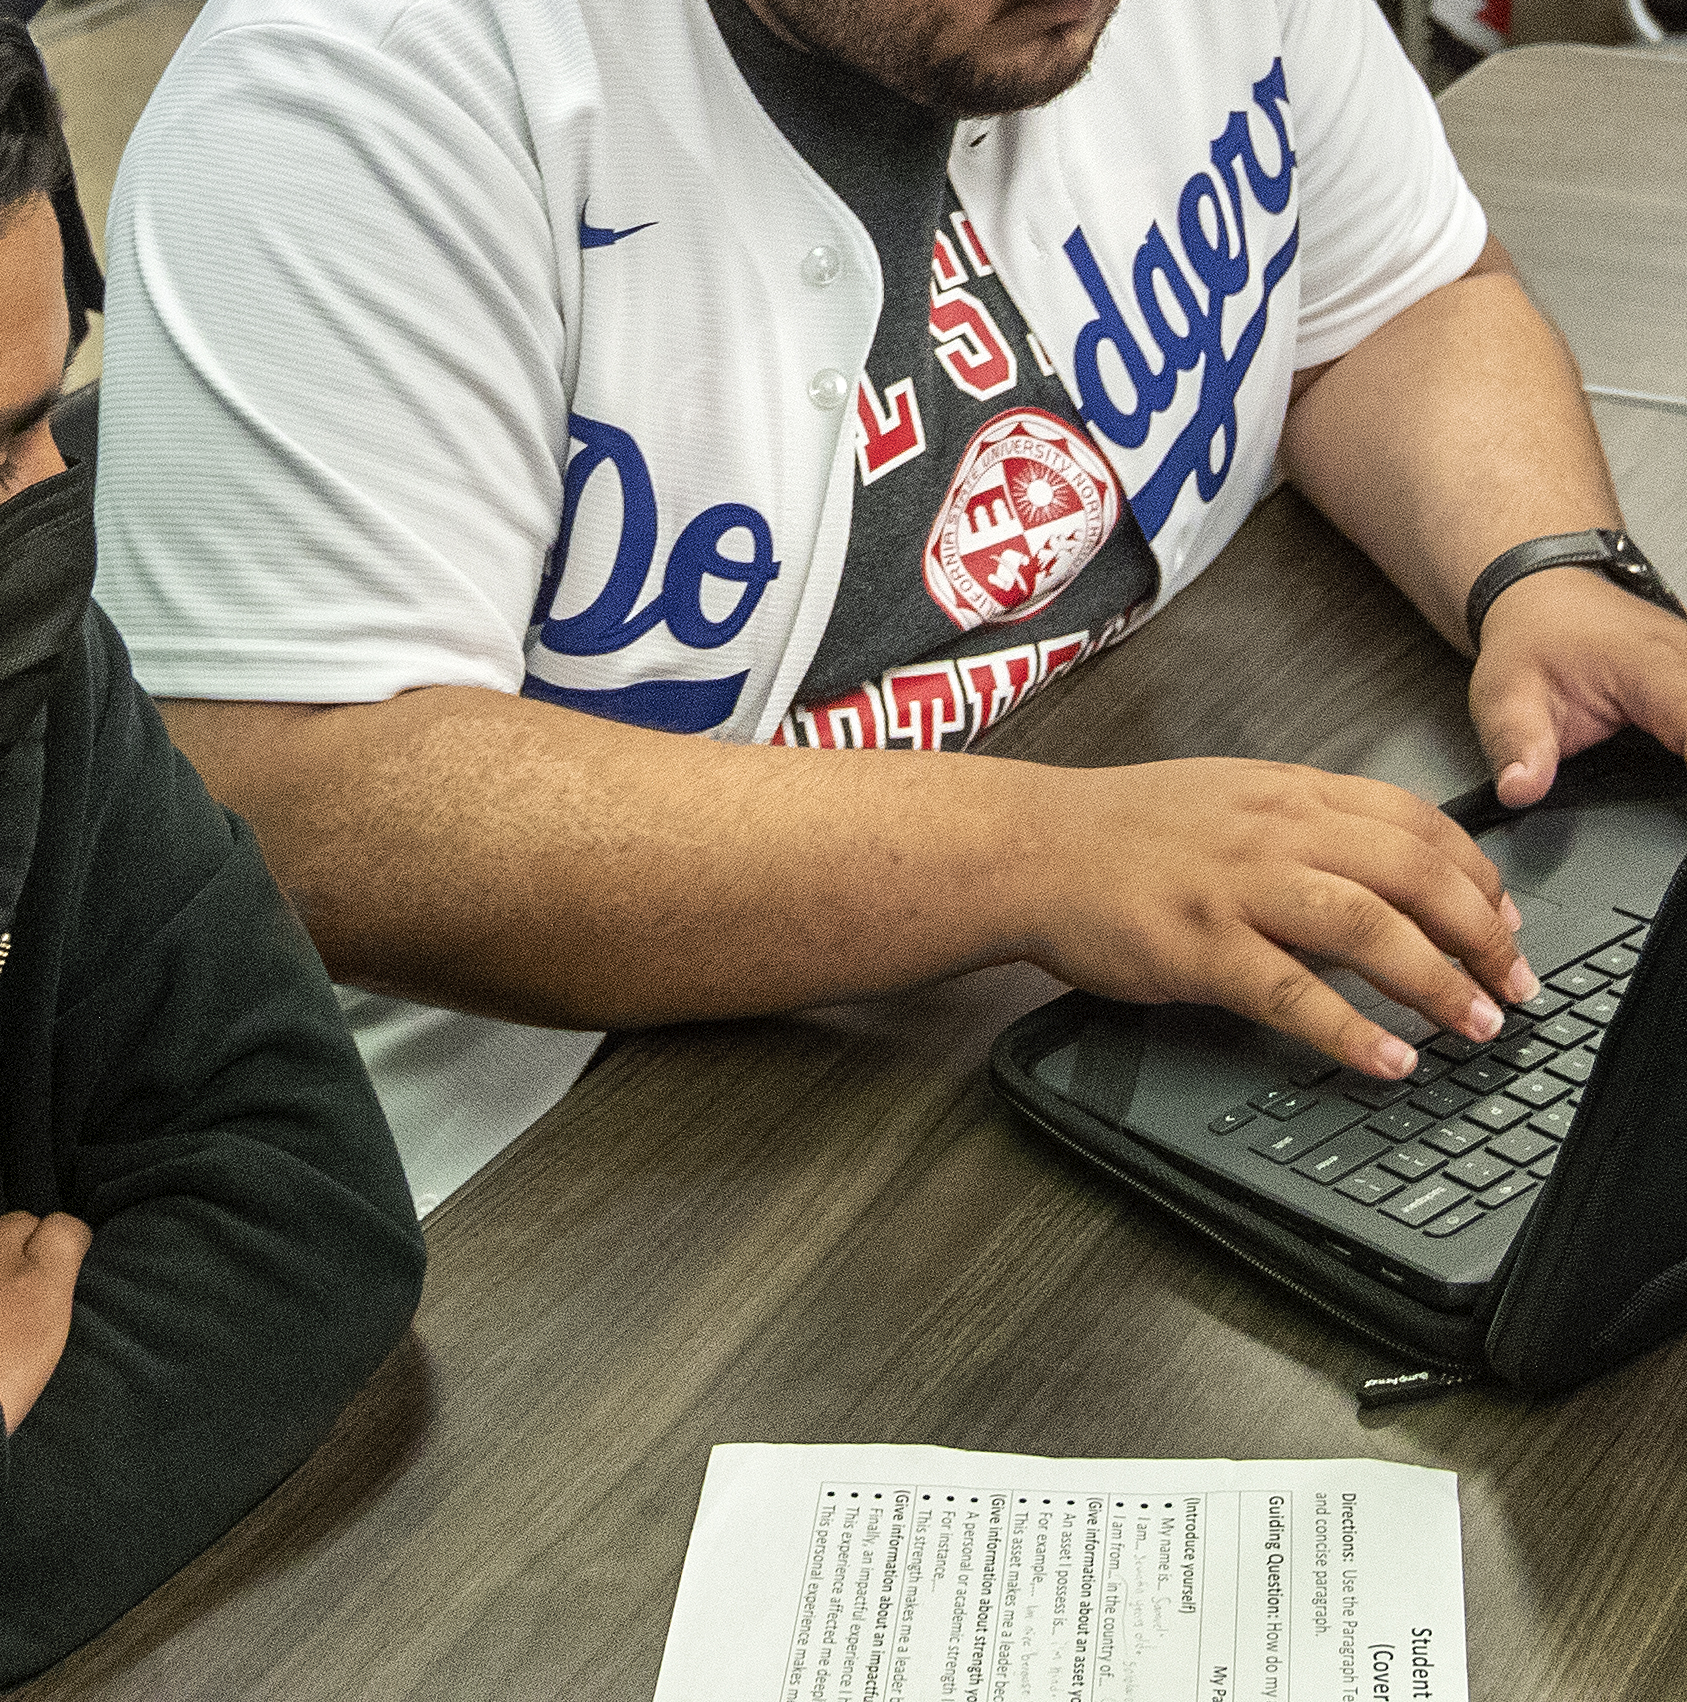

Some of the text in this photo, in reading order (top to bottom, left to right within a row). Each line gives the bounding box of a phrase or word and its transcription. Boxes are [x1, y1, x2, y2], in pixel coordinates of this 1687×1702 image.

[819, 1504, 835, 1526] This
[843, 1506, 859, 1528] This
[893, 1489, 909, 1520] (Give
[914, 1509, 931, 1532] This
[940, 1509, 955, 1529] For
[989, 1493, 1005, 1523] (Give
[1013, 1511, 1027, 1532] This
[1037, 1511, 1051, 1529] For
[1062, 1512, 1075, 1528] An
[1084, 1497, 1102, 1525] (Give
[861, 1507, 883, 1546] Finally,
[1110, 1521, 1122, 1539] am
[1157, 1517, 1173, 1536] My
[1340, 1492, 1356, 1562] Directions:
[809, 1529, 828, 1579] personal
[831, 1531, 852, 1593] experience
[861, 1550, 873, 1563] an
[880, 1523, 902, 1592] information
[907, 1536, 927, 1582] strength
[957, 1522, 975, 1570] personal
[980, 1526, 1001, 1595] information
[1008, 1538, 1022, 1566] asset
[1058, 1531, 1071, 1560] asset
[1079, 1528, 1099, 1597] information
[1157, 1539, 1170, 1570] name
[1178, 1497, 1199, 1614] (Introduce yourself)
[956, 1574, 968, 1585] or
[1312, 1492, 1330, 1636] and concise paragraph.
[1341, 1569, 1356, 1592] Use
[850, 1567, 874, 1620] impactful
[902, 1585, 918, 1621] makes
[1004, 1570, 1019, 1605] makes
[1053, 1570, 1068, 1614] possess
[1107, 1581, 1119, 1591] in
[1260, 1495, 1283, 1697] Guiding Question: How do my
[797, 1582, 819, 1645] experience
[823, 1597, 843, 1644] affected
[875, 1595, 892, 1629] about
[950, 1589, 965, 1643] academic
[975, 1598, 991, 1632] about
[1001, 1609, 1014, 1626] me
[1076, 1601, 1091, 1635] about
[1104, 1595, 1119, 1614] the
[1341, 1596, 1357, 1616] the
[871, 1632, 885, 1647] an
[899, 1624, 911, 1642] me
[1074, 1638, 1086, 1652] an
[1098, 1617, 1116, 1660] country
[789, 1648, 808, 1684] makes
[818, 1647, 832, 1665] me
[839, 1623, 861, 1685] experience
[966, 1635, 987, 1685] strength
[995, 1640, 1012, 1676] leader
[1338, 1620, 1356, 1683] Paragraph
[1411, 1627, 1434, 1699] Student
[891, 1657, 909, 1693] leader
[940, 1645, 959, 1694] strength
[1071, 1655, 1085, 1686] asset
[1210, 1665, 1226, 1685] My
